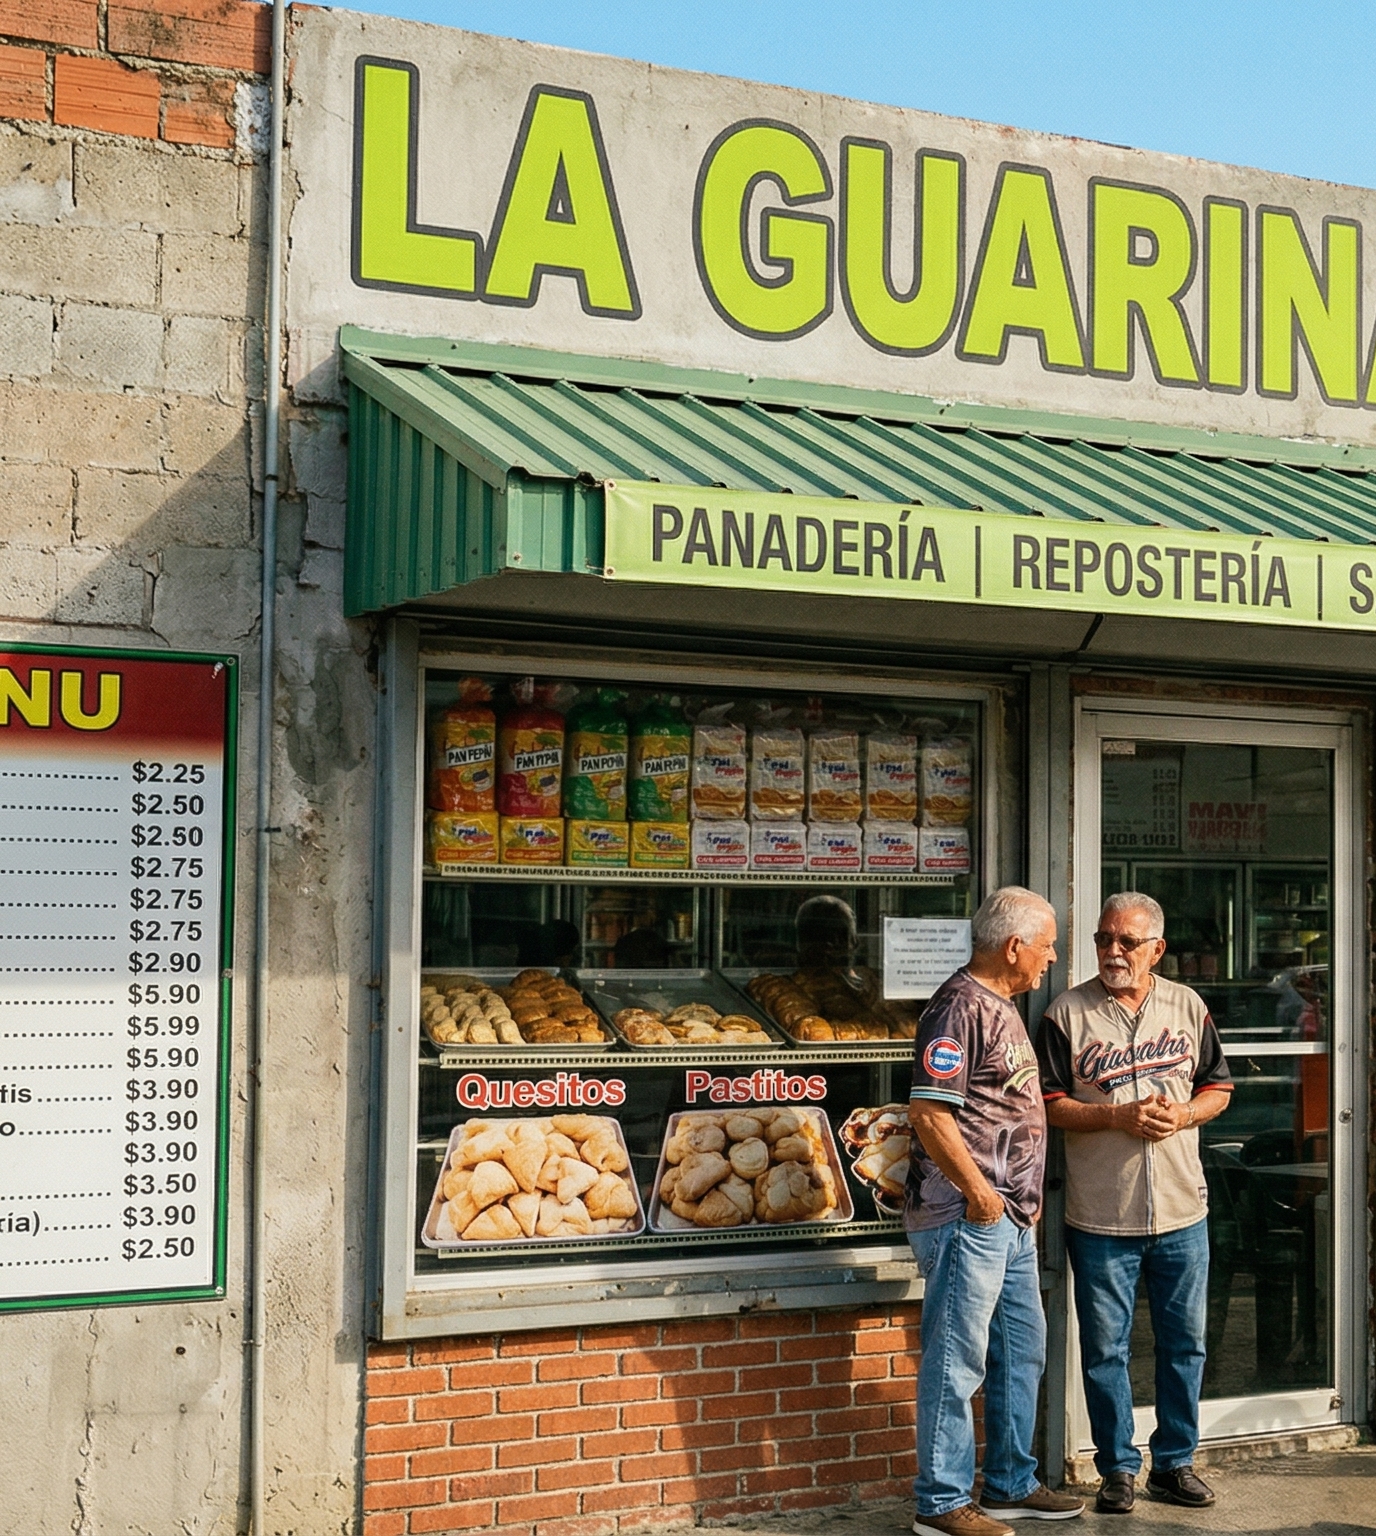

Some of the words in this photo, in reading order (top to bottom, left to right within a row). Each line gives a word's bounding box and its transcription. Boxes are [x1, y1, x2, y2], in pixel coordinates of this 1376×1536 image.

[352, 54, 642, 320] LA
[652, 504, 945, 583] PANADERÍA
[1013, 534, 1291, 608] REPOSTERÍA
[132, 760, 205, 784] $2.25
[581, 758, 599, 771] PAN
[132, 792, 204, 816] $2.50
[131, 823, 203, 848] $2.50
[130, 856, 203, 880] $2.75
[130, 887, 202, 912] $2.75
[129, 919, 202, 944] $2.75
[128, 951, 201, 976] $2.90
[128, 983, 200, 1007] $5.90
[127, 1015, 199, 1040] $5.99
[127, 1045, 198, 1071] $5.90
[126, 1078, 198, 1103] $3.90
[457, 1072, 626, 1108] Quesitos
[685, 1068, 828, 1103] Pastitos
[125, 1110, 197, 1135] $3.90
[124, 1141, 197, 1167] $3.90
[124, 1173, 196, 1198] $3.50
[123, 1205, 195, 1229] $3.90
[122, 1237, 194, 1262] $2.50
